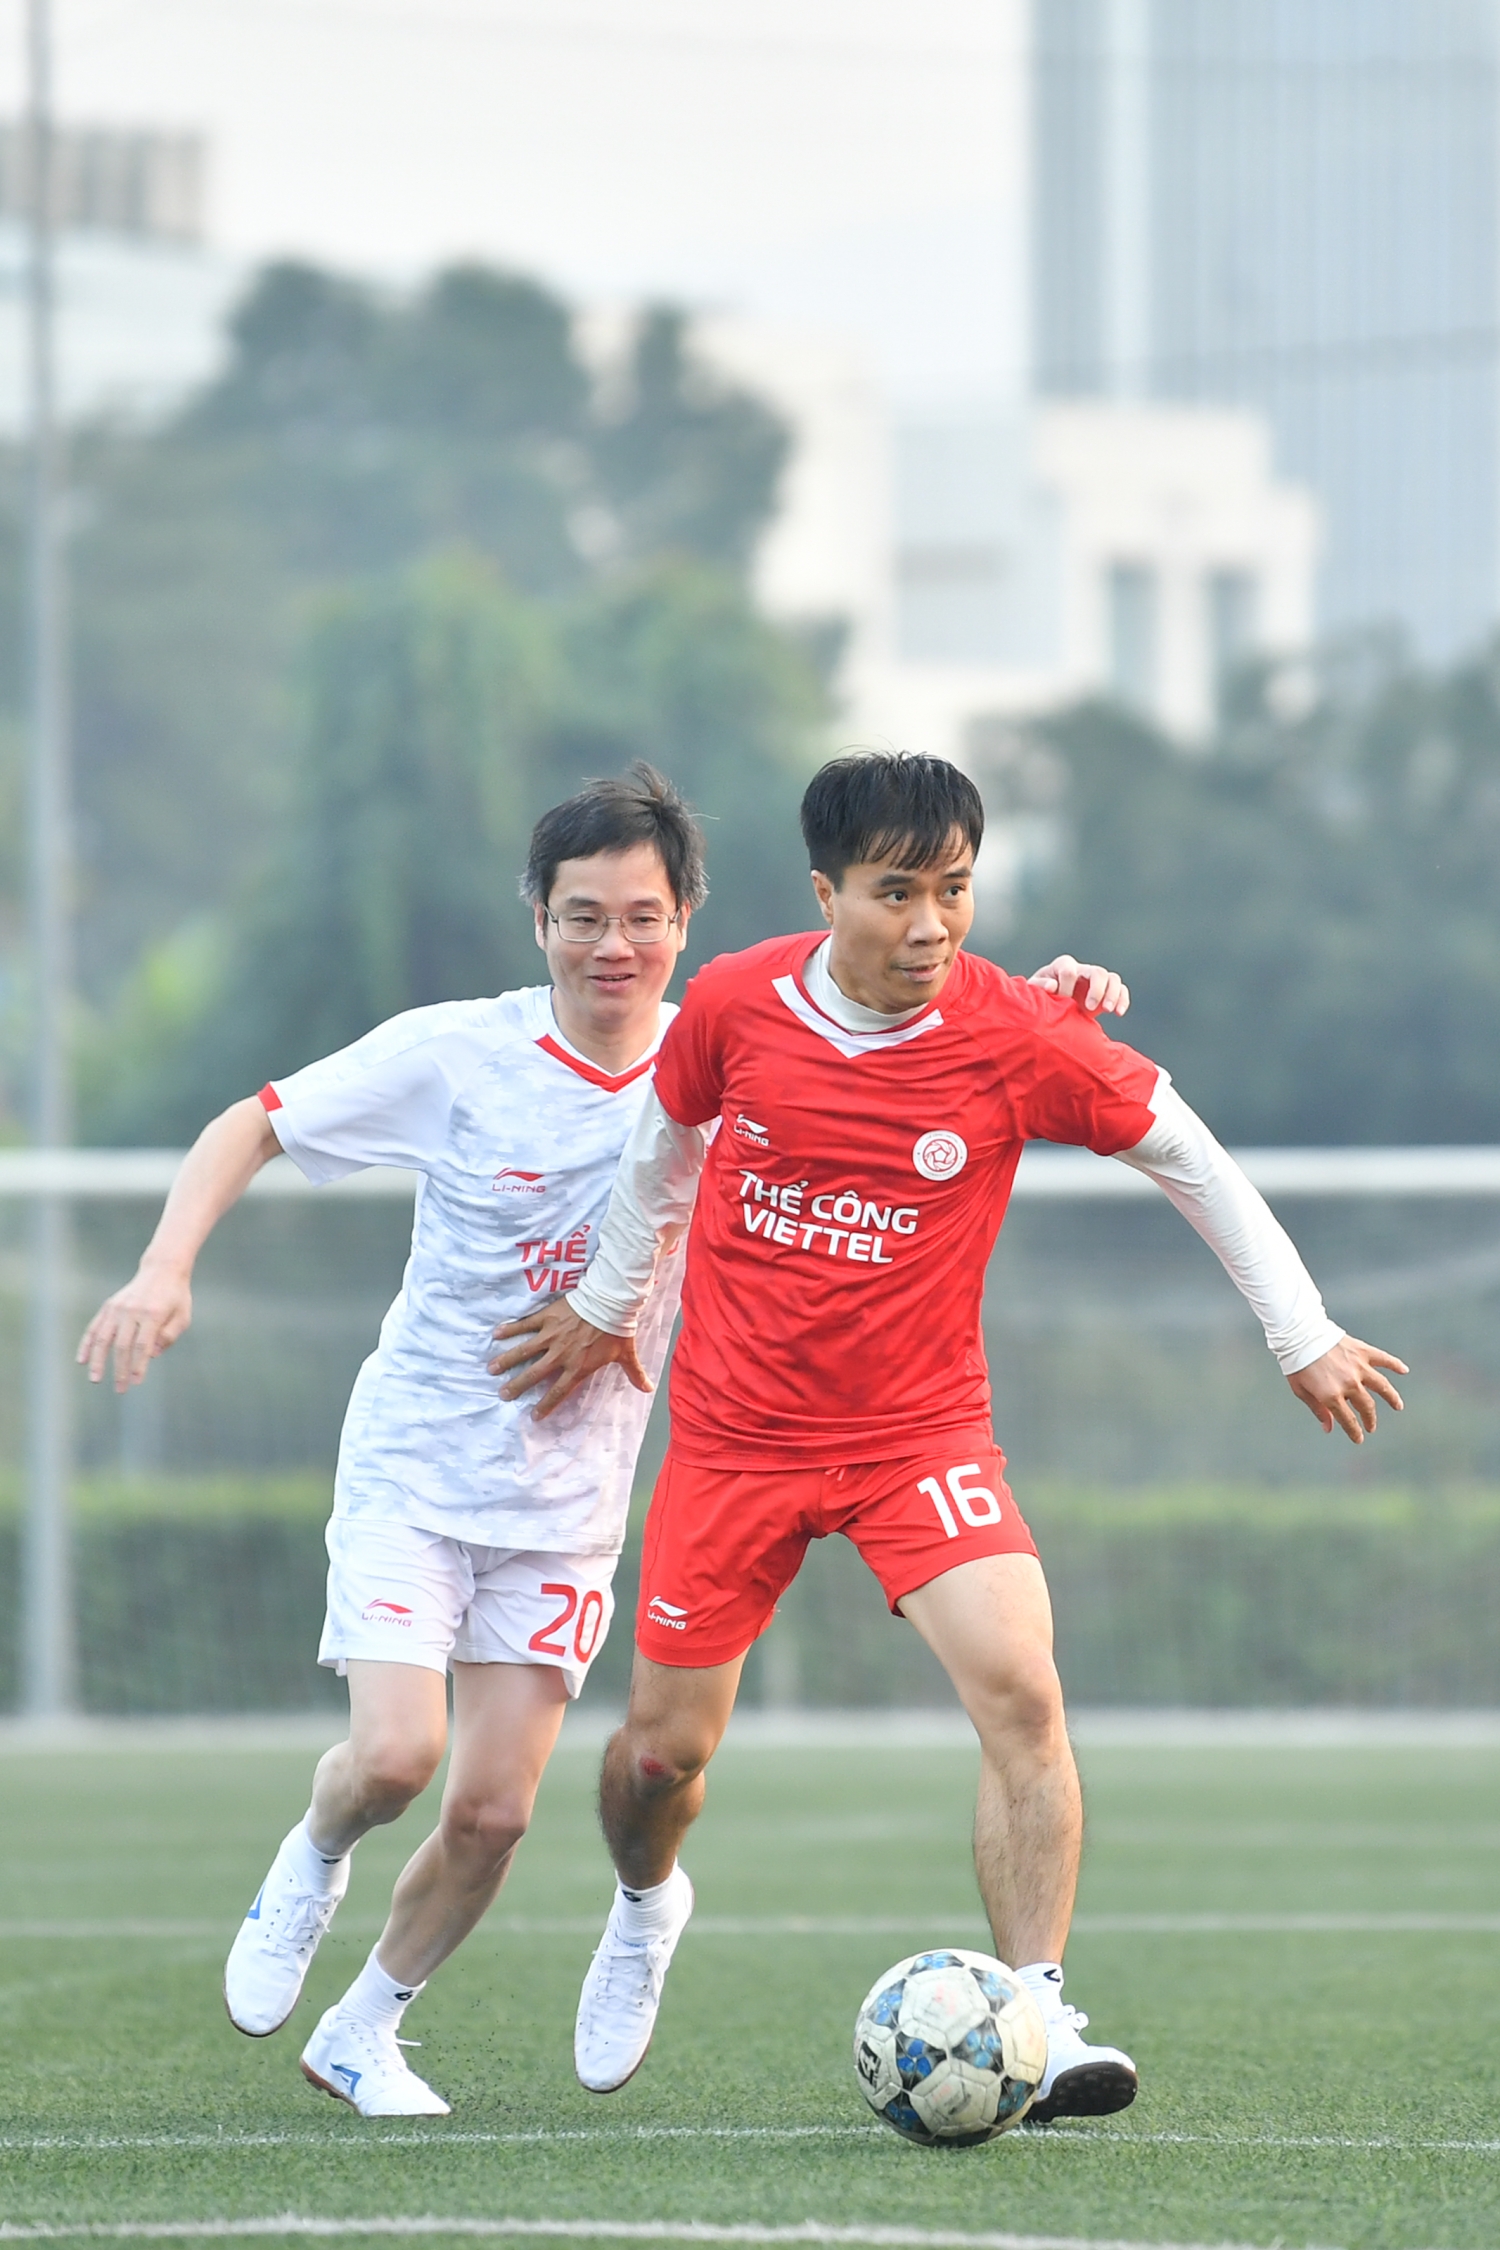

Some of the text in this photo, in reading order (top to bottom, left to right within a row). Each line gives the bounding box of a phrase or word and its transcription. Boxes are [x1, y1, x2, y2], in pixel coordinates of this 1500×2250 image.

[733, 1123, 770, 1147] LI-NING
[492, 1184, 546, 1193] LI-NING
[739, 1170, 919, 1235] THỂ CÔNG
[515, 1224, 591, 1264] THỂ
[743, 1203, 893, 1263] VIETTEL
[524, 1267, 588, 1292] VIE
[918, 1463, 1002, 1538] 16
[361, 1612, 412, 1627] LI-NING
[528, 1583, 602, 1663] 20
[647, 1609, 687, 1630] LI-NING
